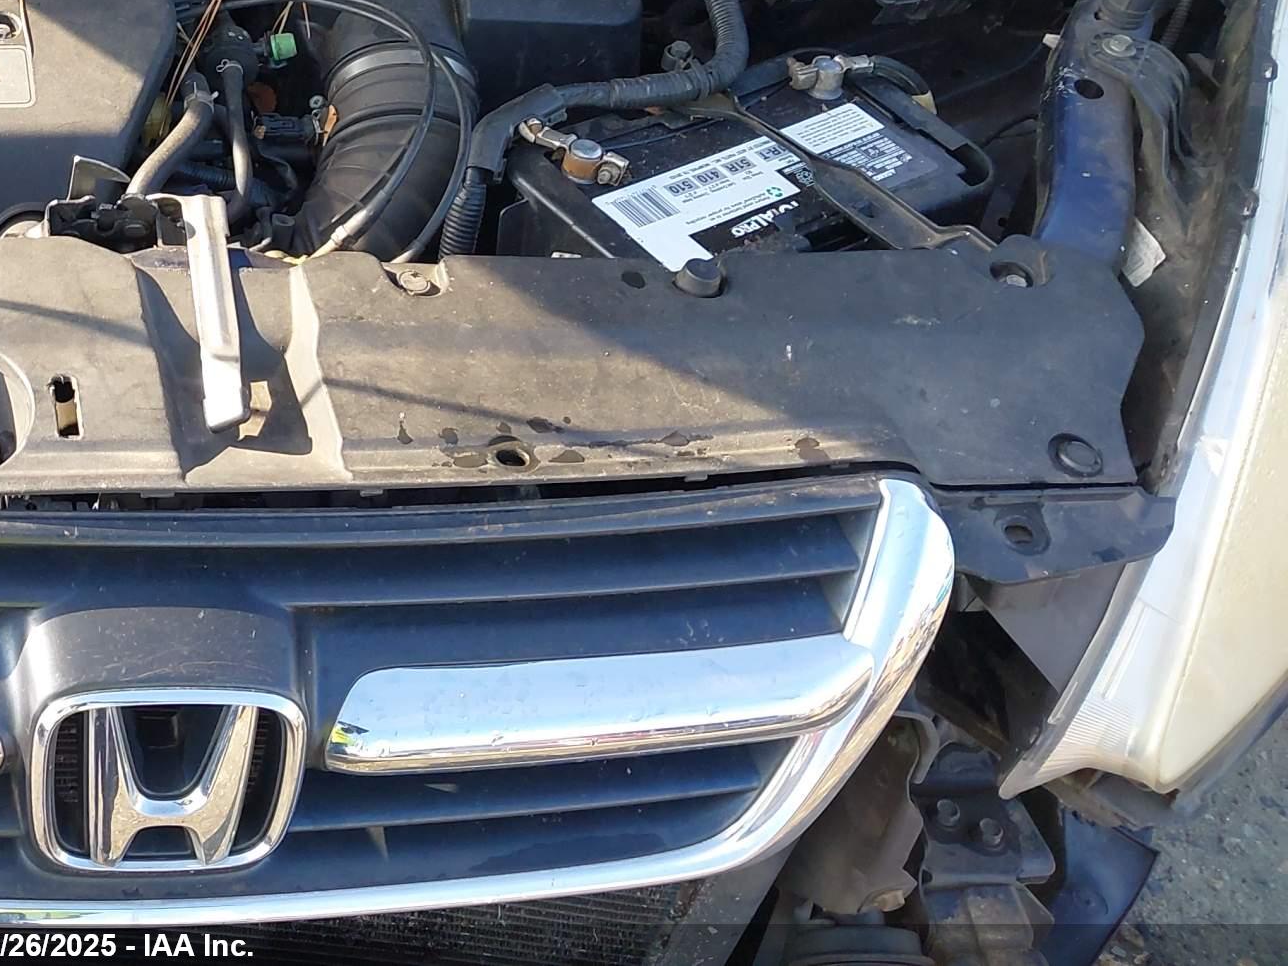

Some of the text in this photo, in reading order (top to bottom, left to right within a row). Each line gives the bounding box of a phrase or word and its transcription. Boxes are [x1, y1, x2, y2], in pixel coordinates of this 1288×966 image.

[756, 144, 788, 160] 1R-T
[723, 158, 753, 173] 51R
[695, 169, 723, 184] 410
[667, 180, 695, 195] 510
